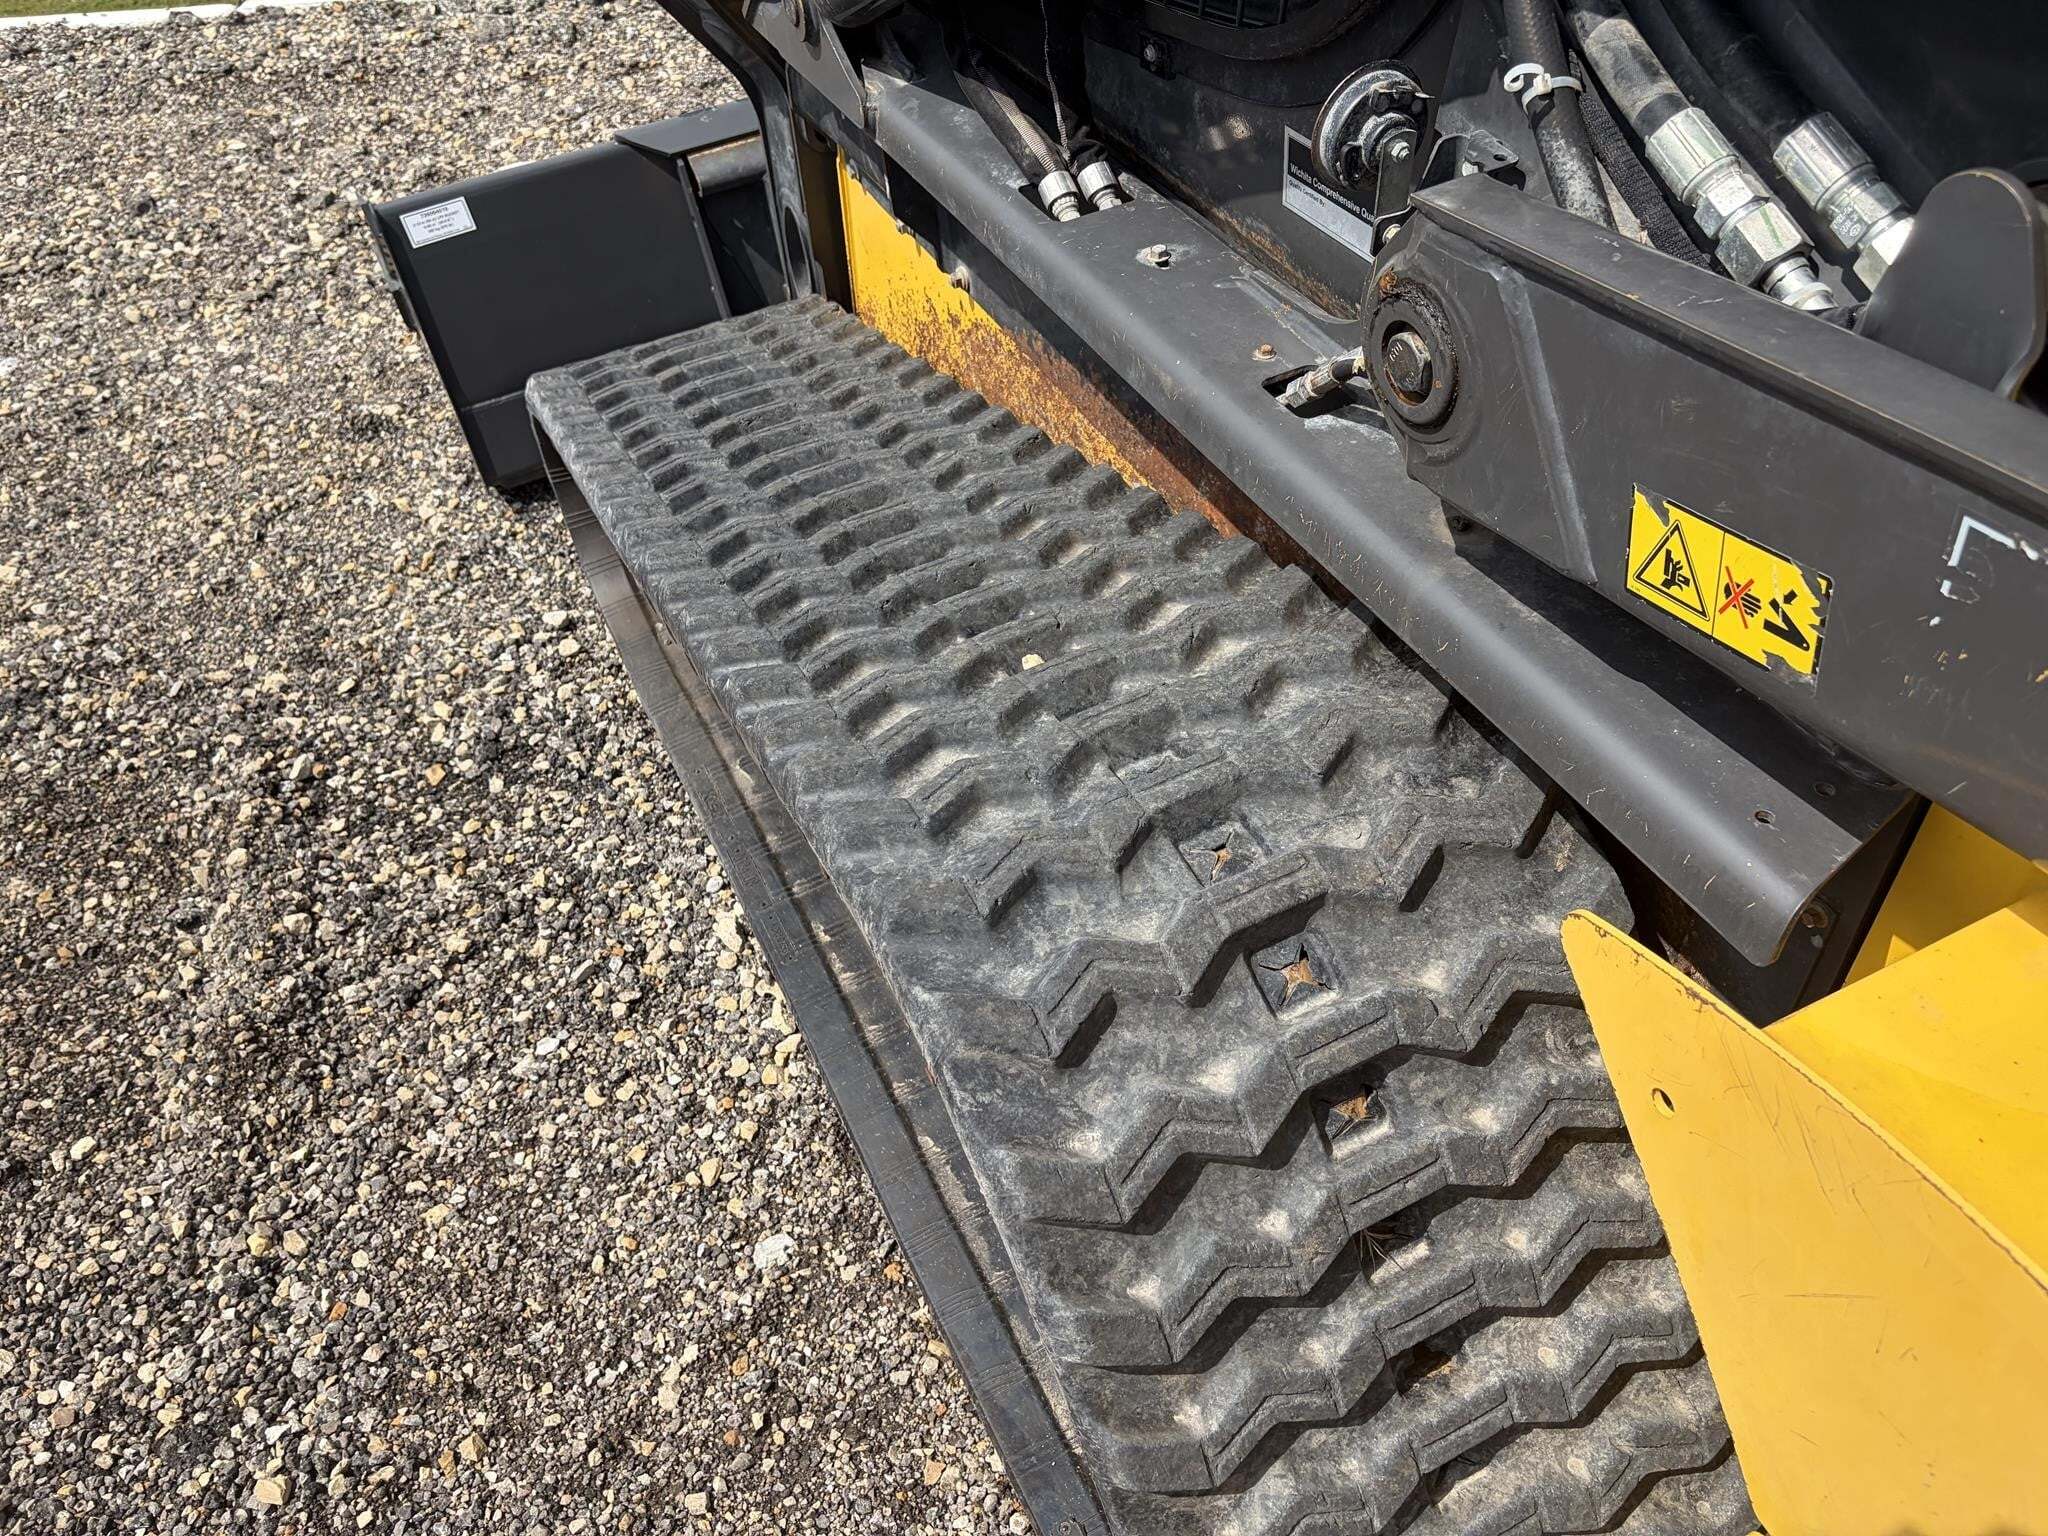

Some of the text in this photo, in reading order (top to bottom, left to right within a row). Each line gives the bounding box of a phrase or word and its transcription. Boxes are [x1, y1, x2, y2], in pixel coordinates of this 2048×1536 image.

[1288, 179, 1302, 192] Quality
[1302, 188, 1319, 202] Certified
[1290, 163, 1312, 184] Wichita
[1312, 178, 1361, 213] Comprehensive
